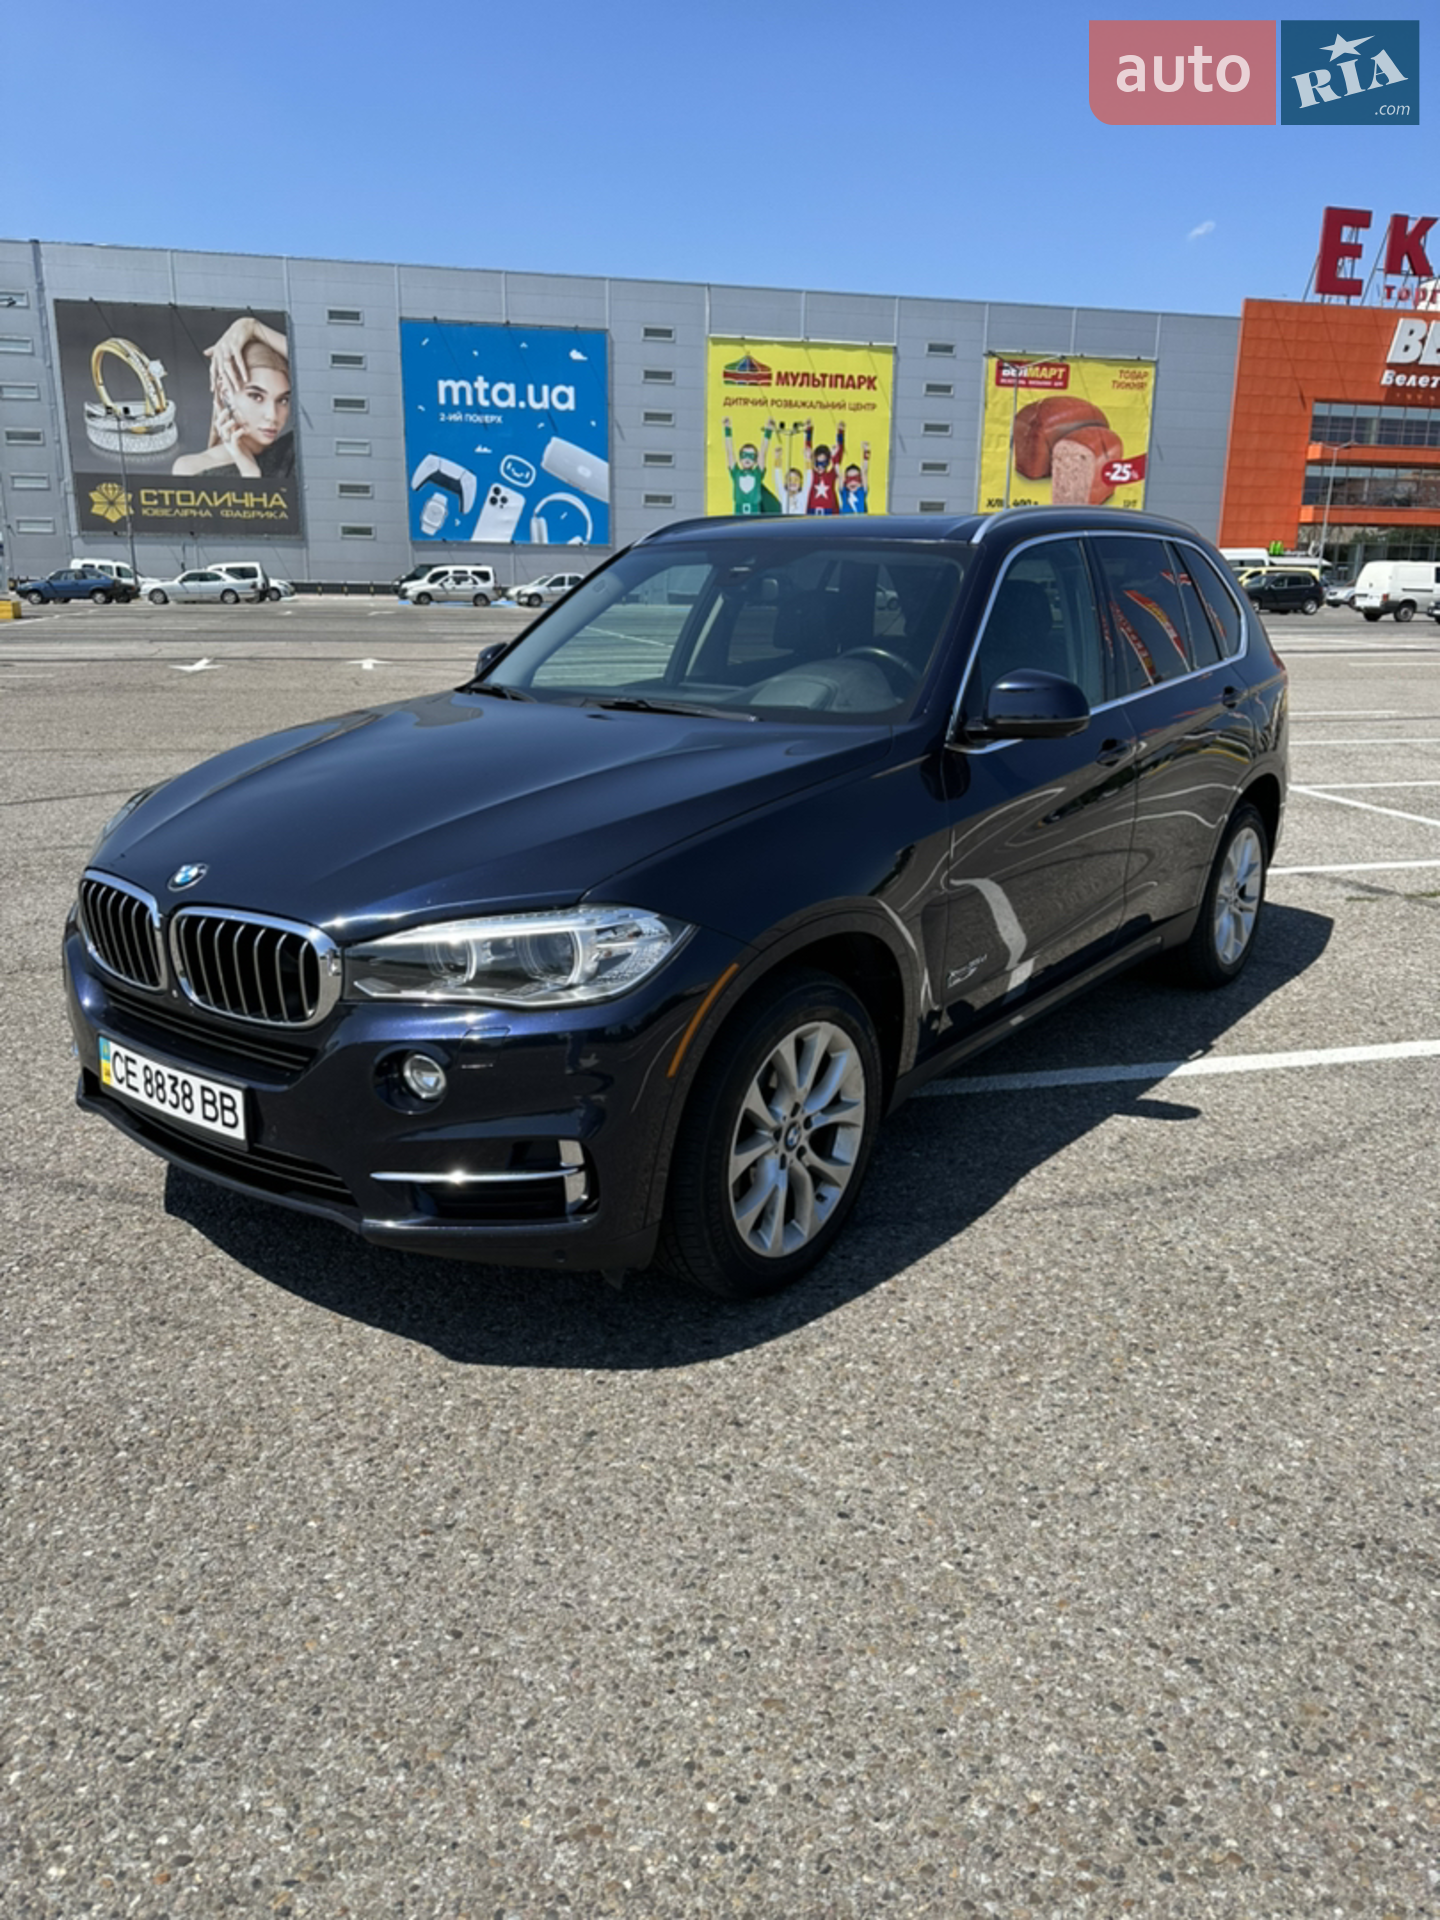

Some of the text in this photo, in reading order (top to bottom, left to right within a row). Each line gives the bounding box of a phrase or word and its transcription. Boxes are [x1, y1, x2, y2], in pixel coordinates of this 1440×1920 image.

[775, 371, 877, 391] МУЛЬТІПАРК
[437, 375, 576, 411] mta.ua
[723, 396, 877, 411] ДИТЯЧИЙ РОЗВАЖАЛЬНИЙ ЦЕНТР
[465, 413, 504, 424] ПОВЕРХ
[140, 489, 288, 509] СТОЛИЧНА
[142, 507, 289, 519] ЮВЕЛІРНА ФАБРИКА
[112, 1051, 239, 1129] CE 8838 BB
